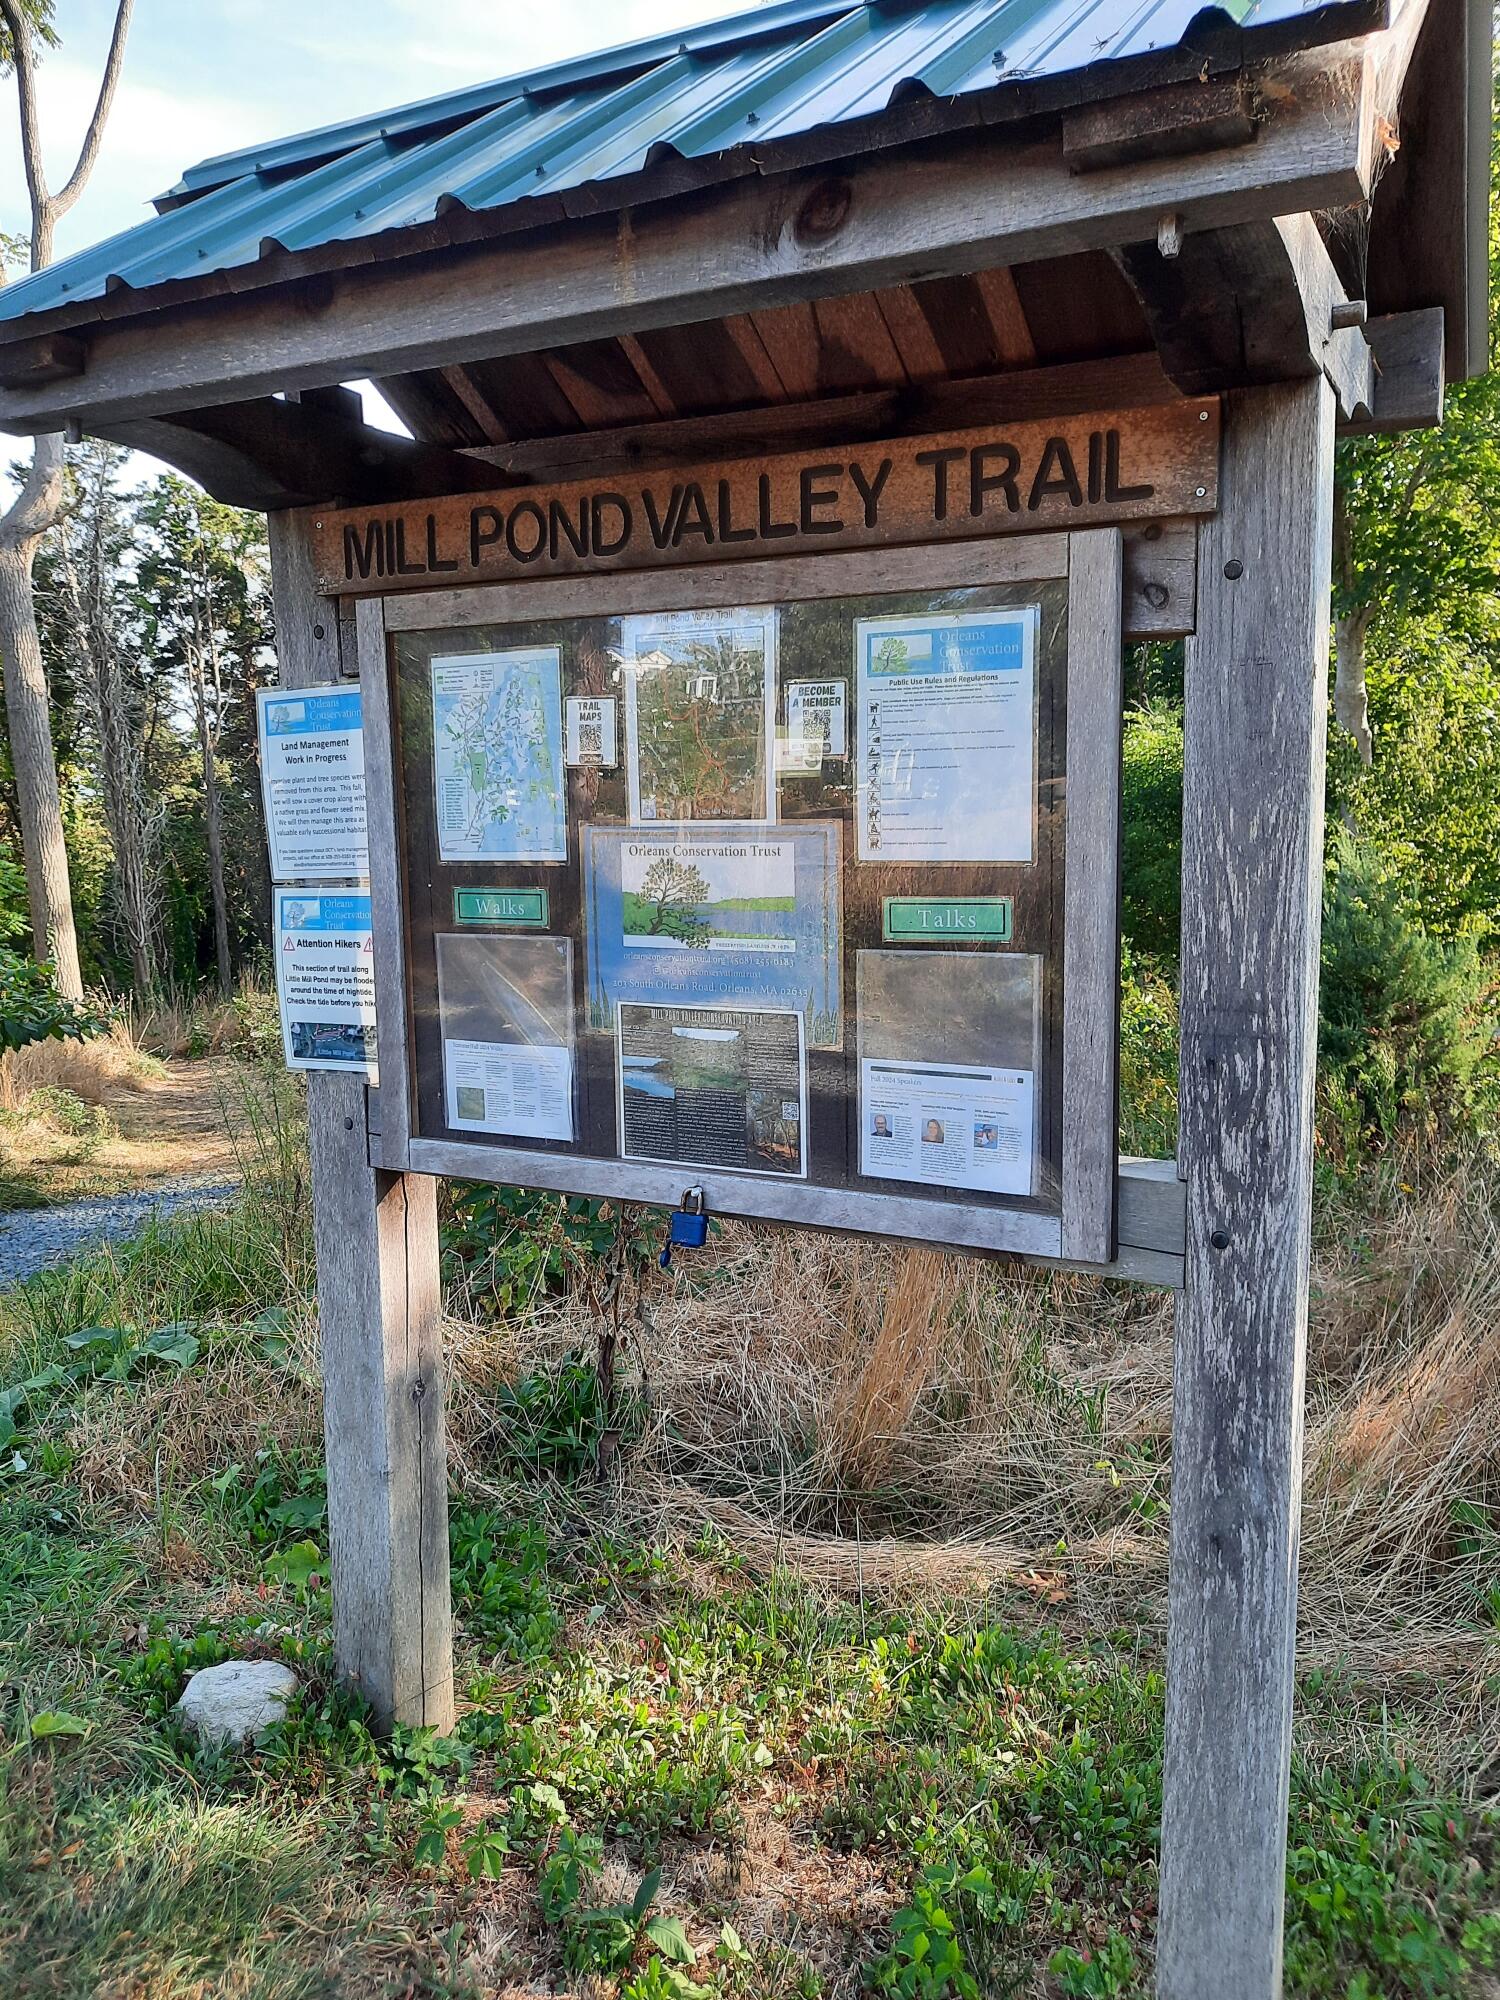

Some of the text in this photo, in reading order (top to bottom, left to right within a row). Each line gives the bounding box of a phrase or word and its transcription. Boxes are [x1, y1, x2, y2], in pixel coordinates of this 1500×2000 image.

[343, 429, 1155, 580] MILL POND VALLEY TRAIL
[716, 609, 733, 619] Trail
[940, 630, 986, 643] Orleans
[940, 642, 1019, 658] Conservation
[941, 661, 970, 672] Trust
[910, 677, 923, 685] Use
[924, 676, 943, 684] Rules
[944, 675, 957, 683] and
[958, 673, 998, 683] Regulations
[798, 686, 836, 696] BECOME
[308, 699, 340, 709] Orleans
[578, 702, 601, 710] TRAIL
[792, 697, 841, 707] A MEMBER
[579, 712, 602, 721] MAPS
[311, 721, 332, 731] Trust
[281, 738, 349, 751] Land Management
[285, 755, 304, 764] Work
[315, 753, 347, 763] Progress
[330, 774, 350, 782] species
[299, 828, 311, 836] early
[312, 827, 346, 835] successional
[628, 844, 782, 857] Orleans Conservation Trust
[324, 899, 353, 908] Orleans
[475, 898, 525, 915] Walks
[324, 909, 371, 919] Conservatio
[918, 909, 977, 928] Talks
[326, 921, 344, 930] Trust
[297, 939, 361, 949] Attention Hikers
[351, 966, 369, 974] along
[301, 975, 312, 983] Mill
[613, 979, 627, 989] 203
[629, 978, 655, 989] South
[656, 979, 688, 990] Orleans
[719, 983, 757, 995] Orleans,
[759, 984, 778, 995] MA
